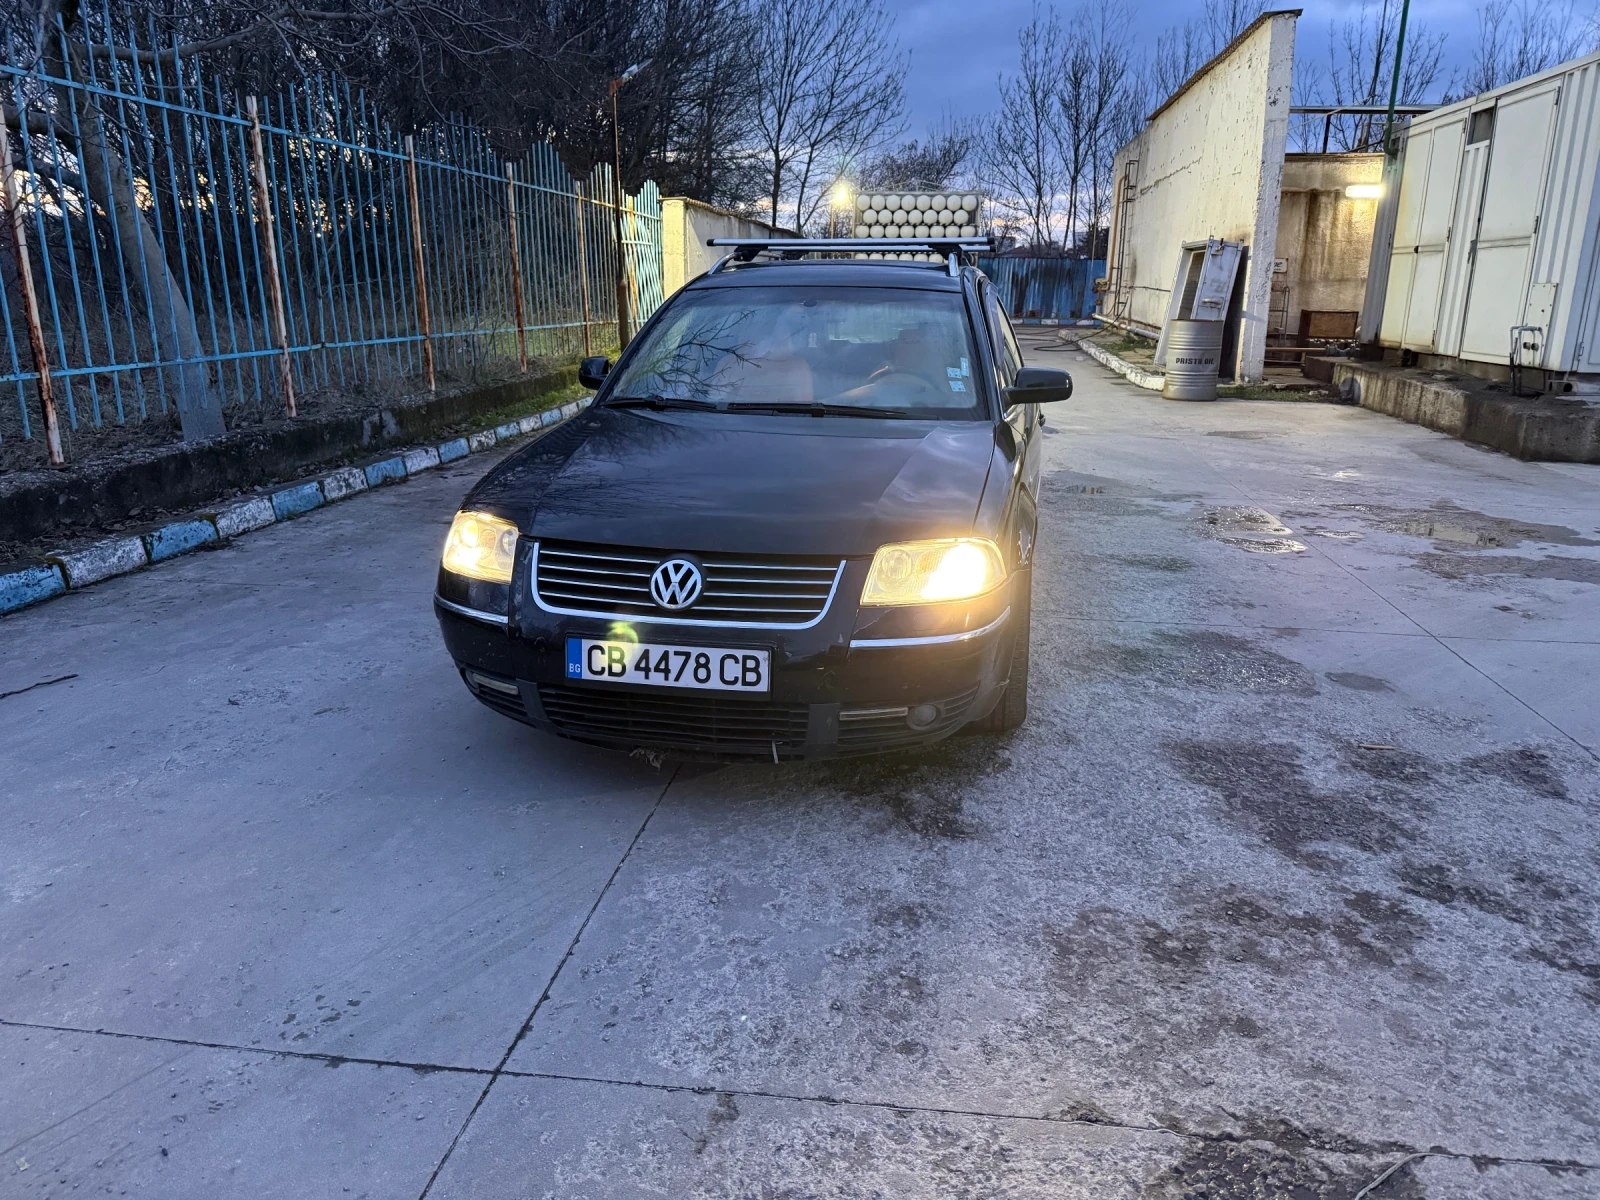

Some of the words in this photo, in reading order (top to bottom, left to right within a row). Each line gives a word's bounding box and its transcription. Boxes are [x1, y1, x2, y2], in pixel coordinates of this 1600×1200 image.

[1204, 357, 1215, 365] OIL
[650, 559, 702, 610] VW
[569, 663, 581, 673] BG
[587, 644, 627, 677] CB
[634, 648, 711, 684] 4478
[719, 653, 762, 687] CB
